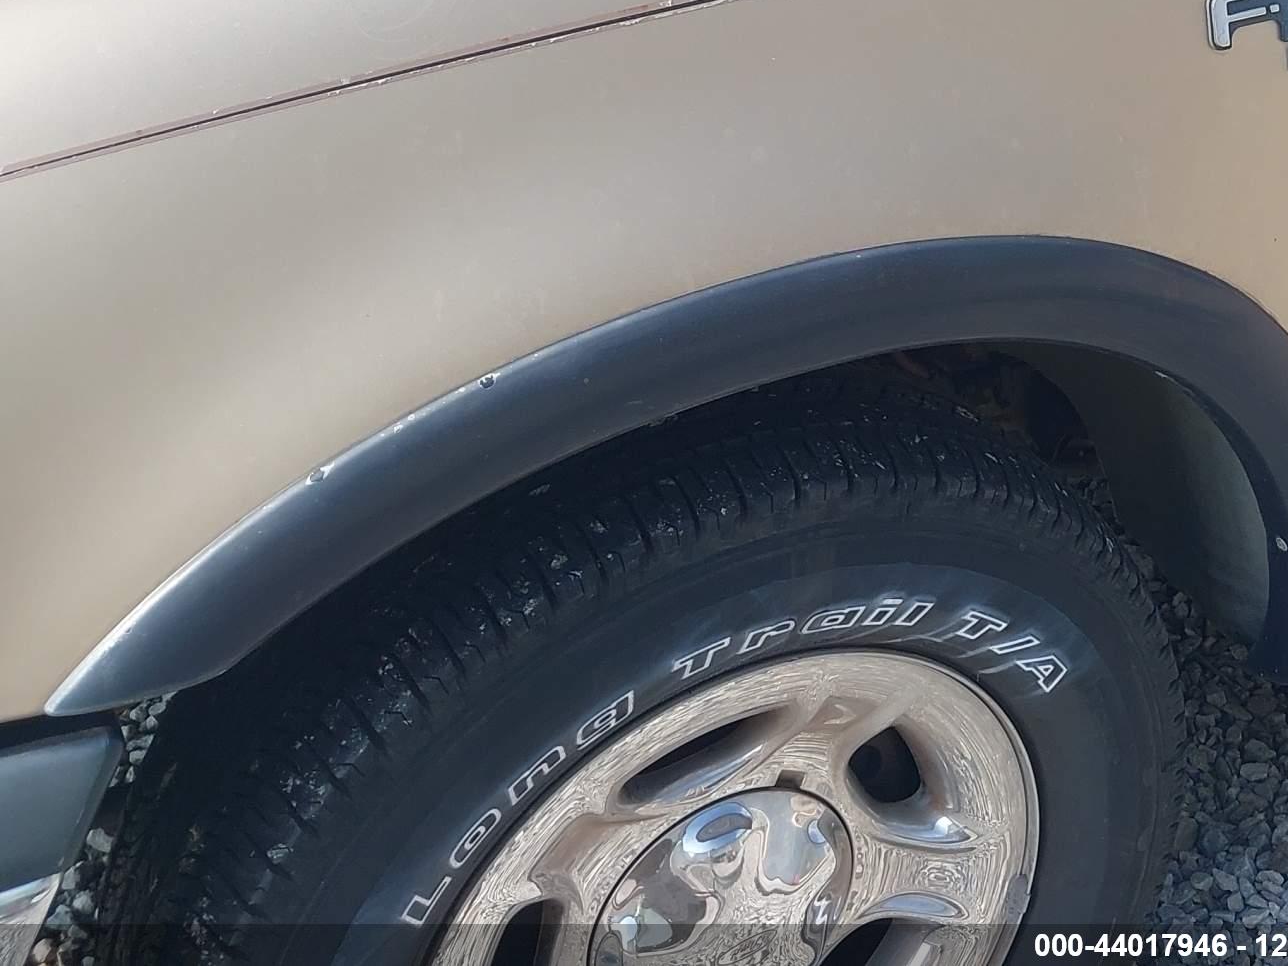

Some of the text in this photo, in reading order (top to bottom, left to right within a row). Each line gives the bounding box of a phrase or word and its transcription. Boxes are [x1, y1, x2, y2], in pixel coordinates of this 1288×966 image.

[402, 598, 1072, 928] Long Trail T/A
